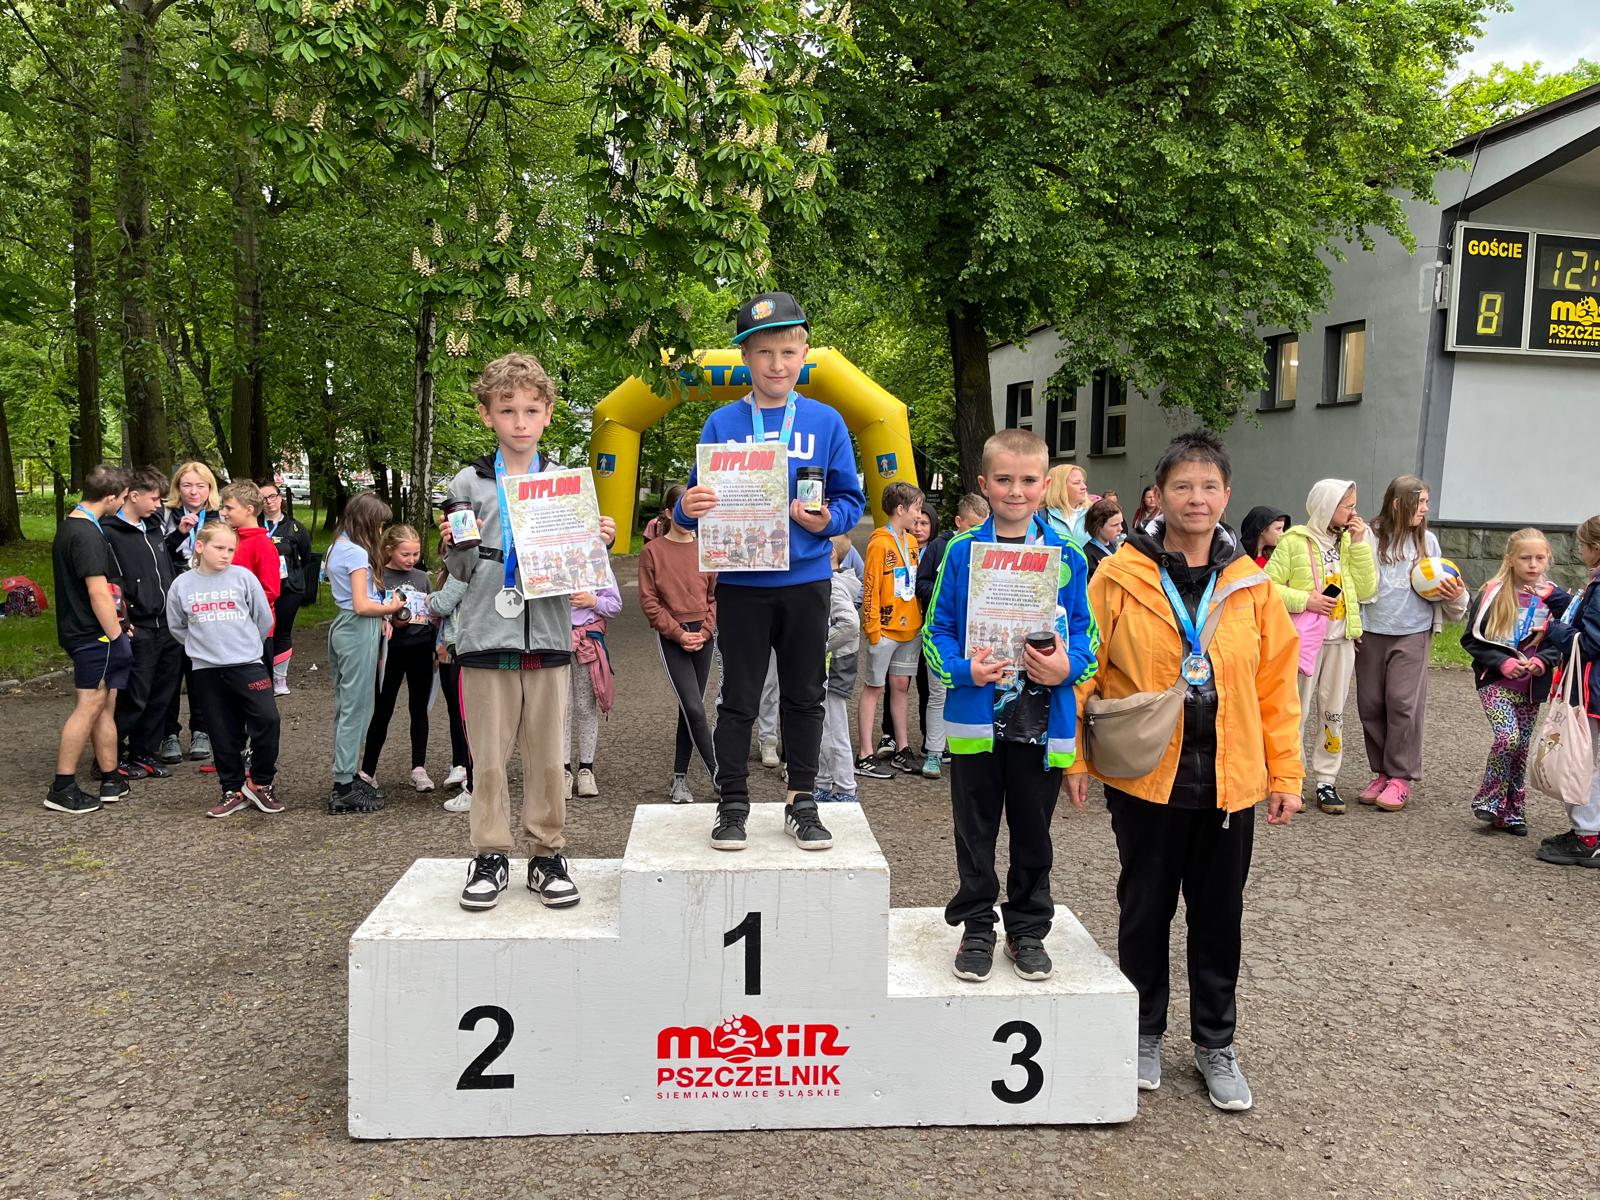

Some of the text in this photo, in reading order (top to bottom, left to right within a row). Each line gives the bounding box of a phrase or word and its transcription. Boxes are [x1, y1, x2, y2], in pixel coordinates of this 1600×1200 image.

[1468, 238, 1523, 258] GOŚCIE
[1477, 293, 1502, 334] 8
[709, 450, 776, 472] DYPLOM
[518, 475, 582, 501] DYPLOM
[981, 549, 1050, 573] DYPLOM
[187, 589, 239, 604] street
[191, 600, 236, 614] dance
[723, 911, 762, 995] 1
[456, 1004, 515, 1090] 2
[991, 1019, 1044, 1104] 3
[657, 1064, 841, 1088] PSZCZELNIK
[656, 1090, 769, 1099] SIEMIANOWICE
